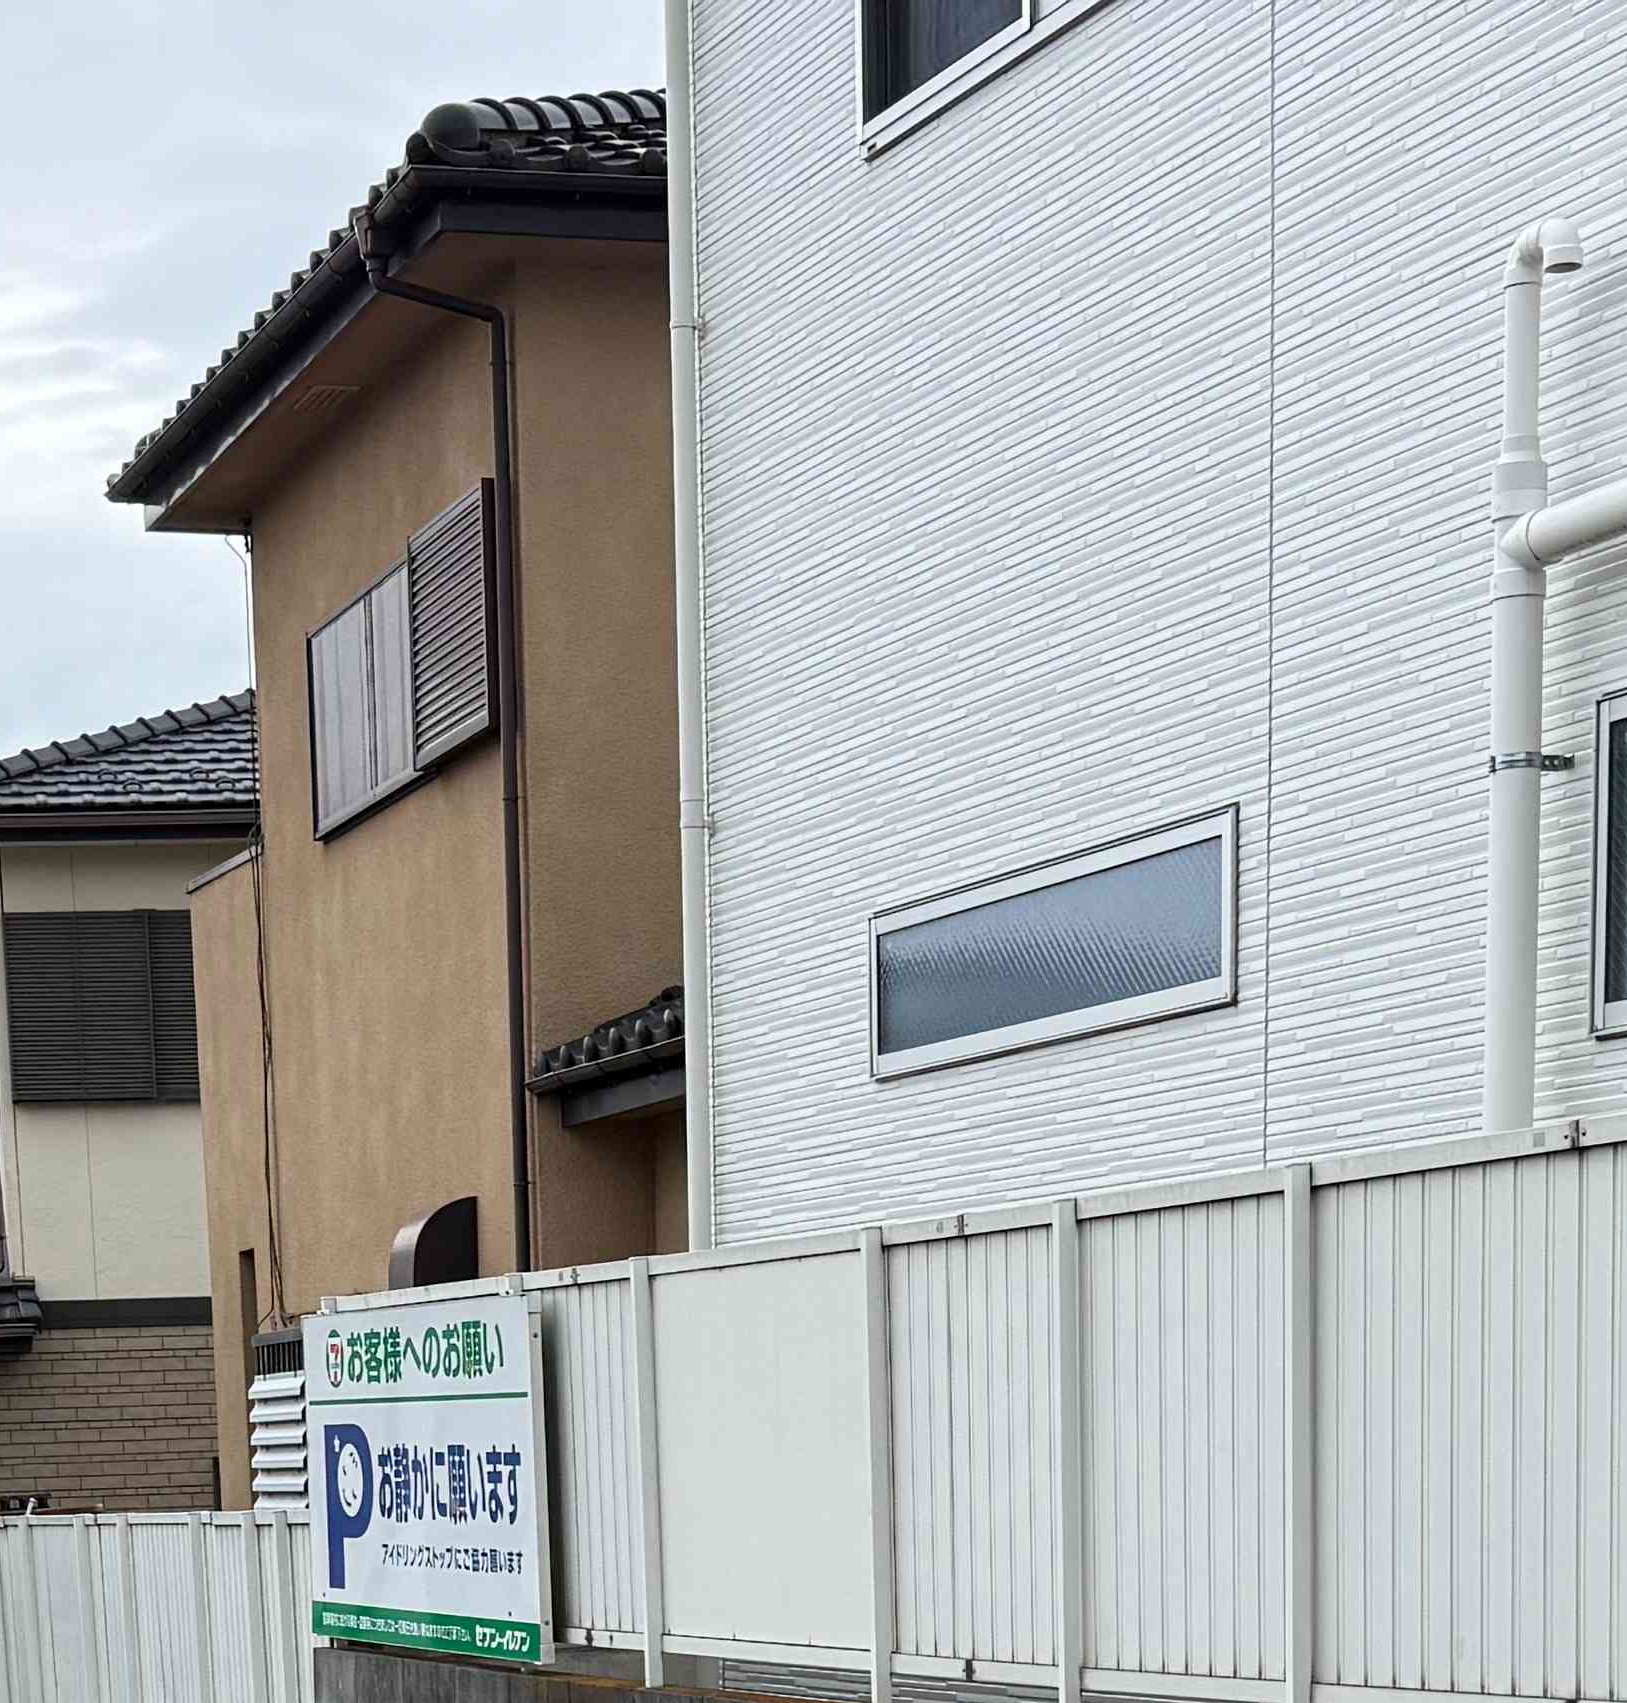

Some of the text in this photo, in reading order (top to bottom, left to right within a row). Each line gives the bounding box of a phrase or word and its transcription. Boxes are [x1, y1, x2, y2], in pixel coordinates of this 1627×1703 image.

[347, 1320, 505, 1385] お客様へのお願い
[377, 1443, 523, 1526] お静かに願います
[382, 1543, 524, 1575] アイドリングストップにご協力願います
